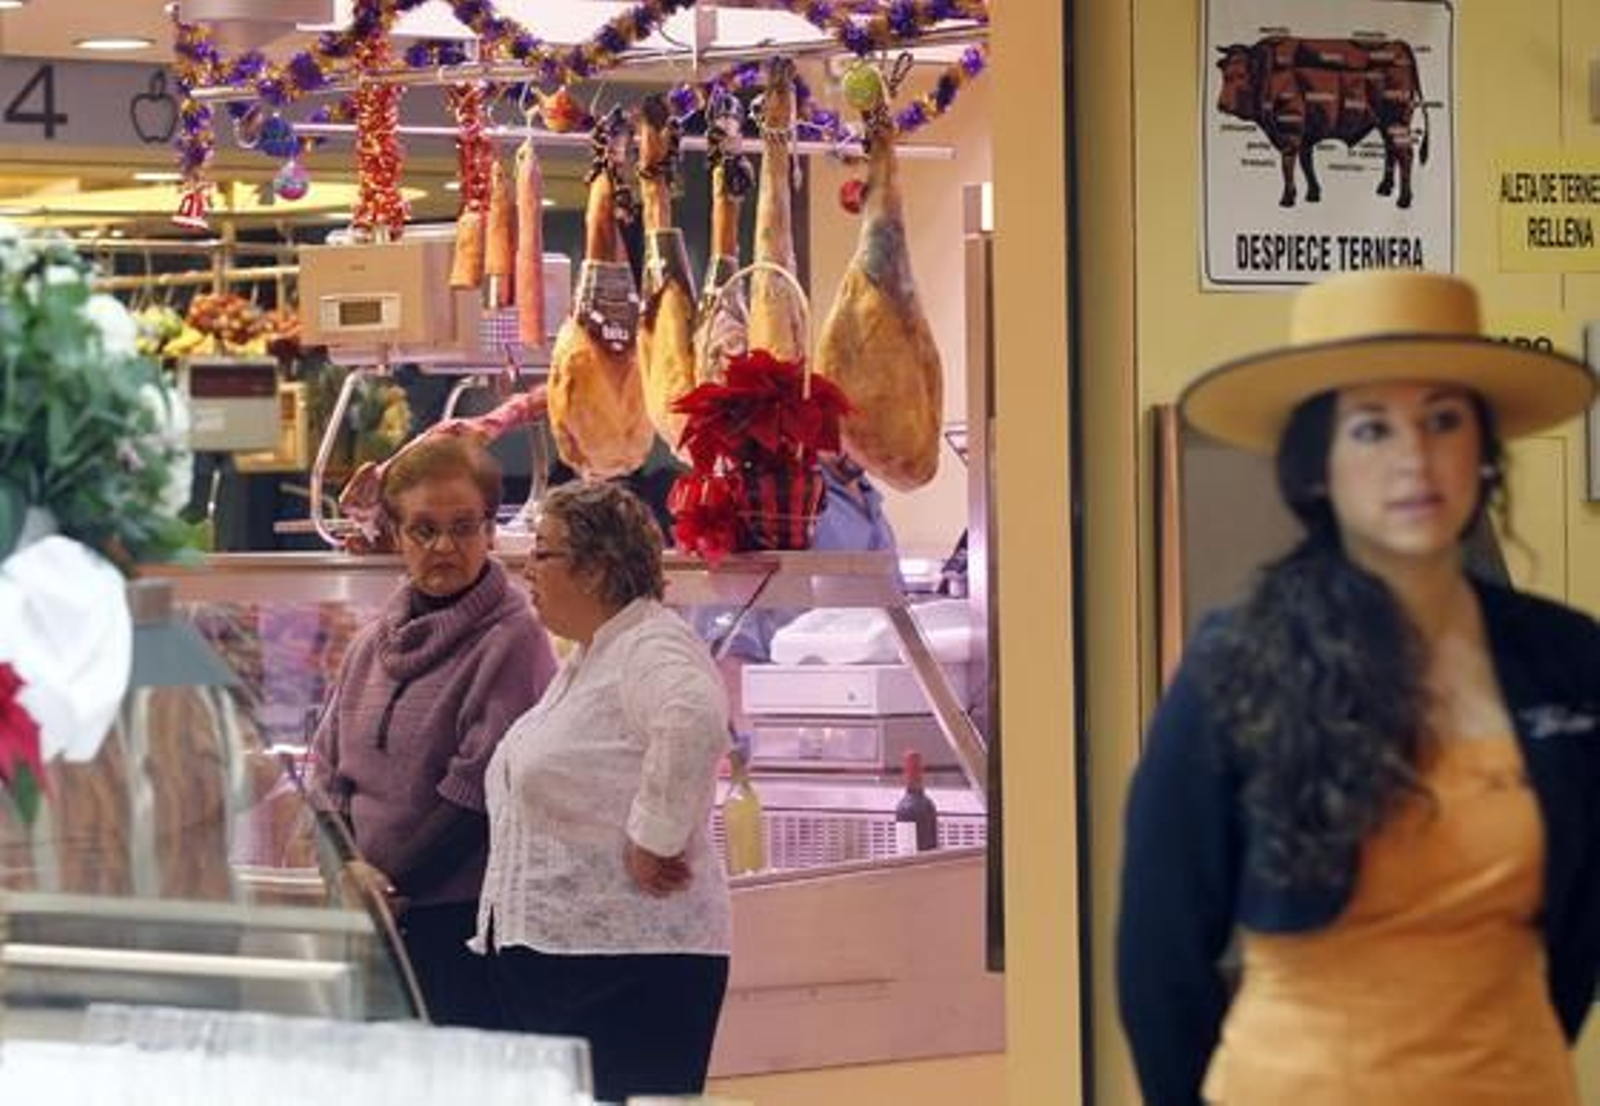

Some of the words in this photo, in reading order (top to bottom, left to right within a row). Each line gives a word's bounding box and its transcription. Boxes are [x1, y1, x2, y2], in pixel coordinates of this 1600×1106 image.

[4, 65, 69, 139] 4
[1499, 173, 1540, 203] ALETA
[1541, 173, 1557, 203] DE
[1527, 217, 1595, 248] RELLENA
[1236, 234, 1331, 271] DESPIECE
[1337, 236, 1423, 271] TERNERA
